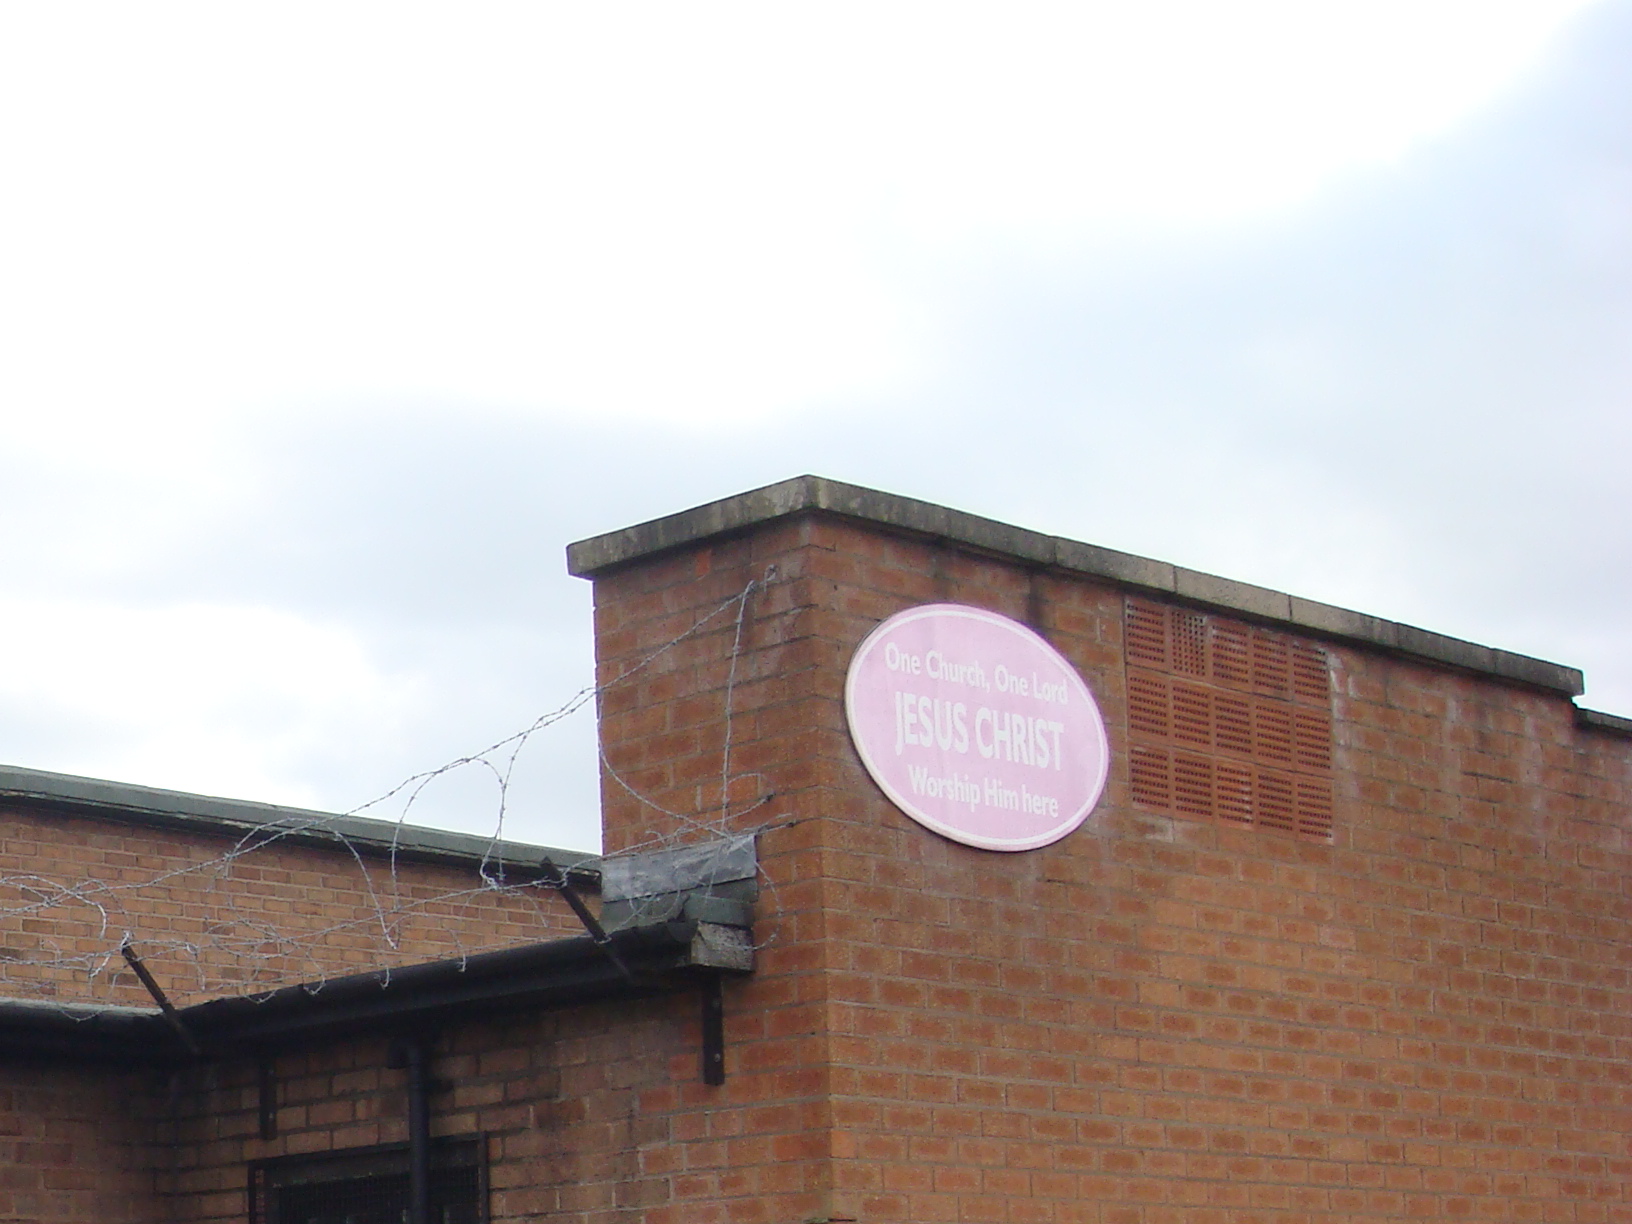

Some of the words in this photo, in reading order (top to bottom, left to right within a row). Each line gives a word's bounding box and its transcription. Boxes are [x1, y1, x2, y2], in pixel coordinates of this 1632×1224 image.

[884, 641, 921, 674] One
[926, 651, 990, 693] Church,
[994, 665, 1028, 697] One
[1032, 672, 1069, 705] Lord
[895, 691, 970, 756] JESUS
[975, 707, 1065, 771] CHRIST
[907, 764, 981, 813] Worship
[984, 777, 1019, 811] Him
[1021, 784, 1059, 818] here
